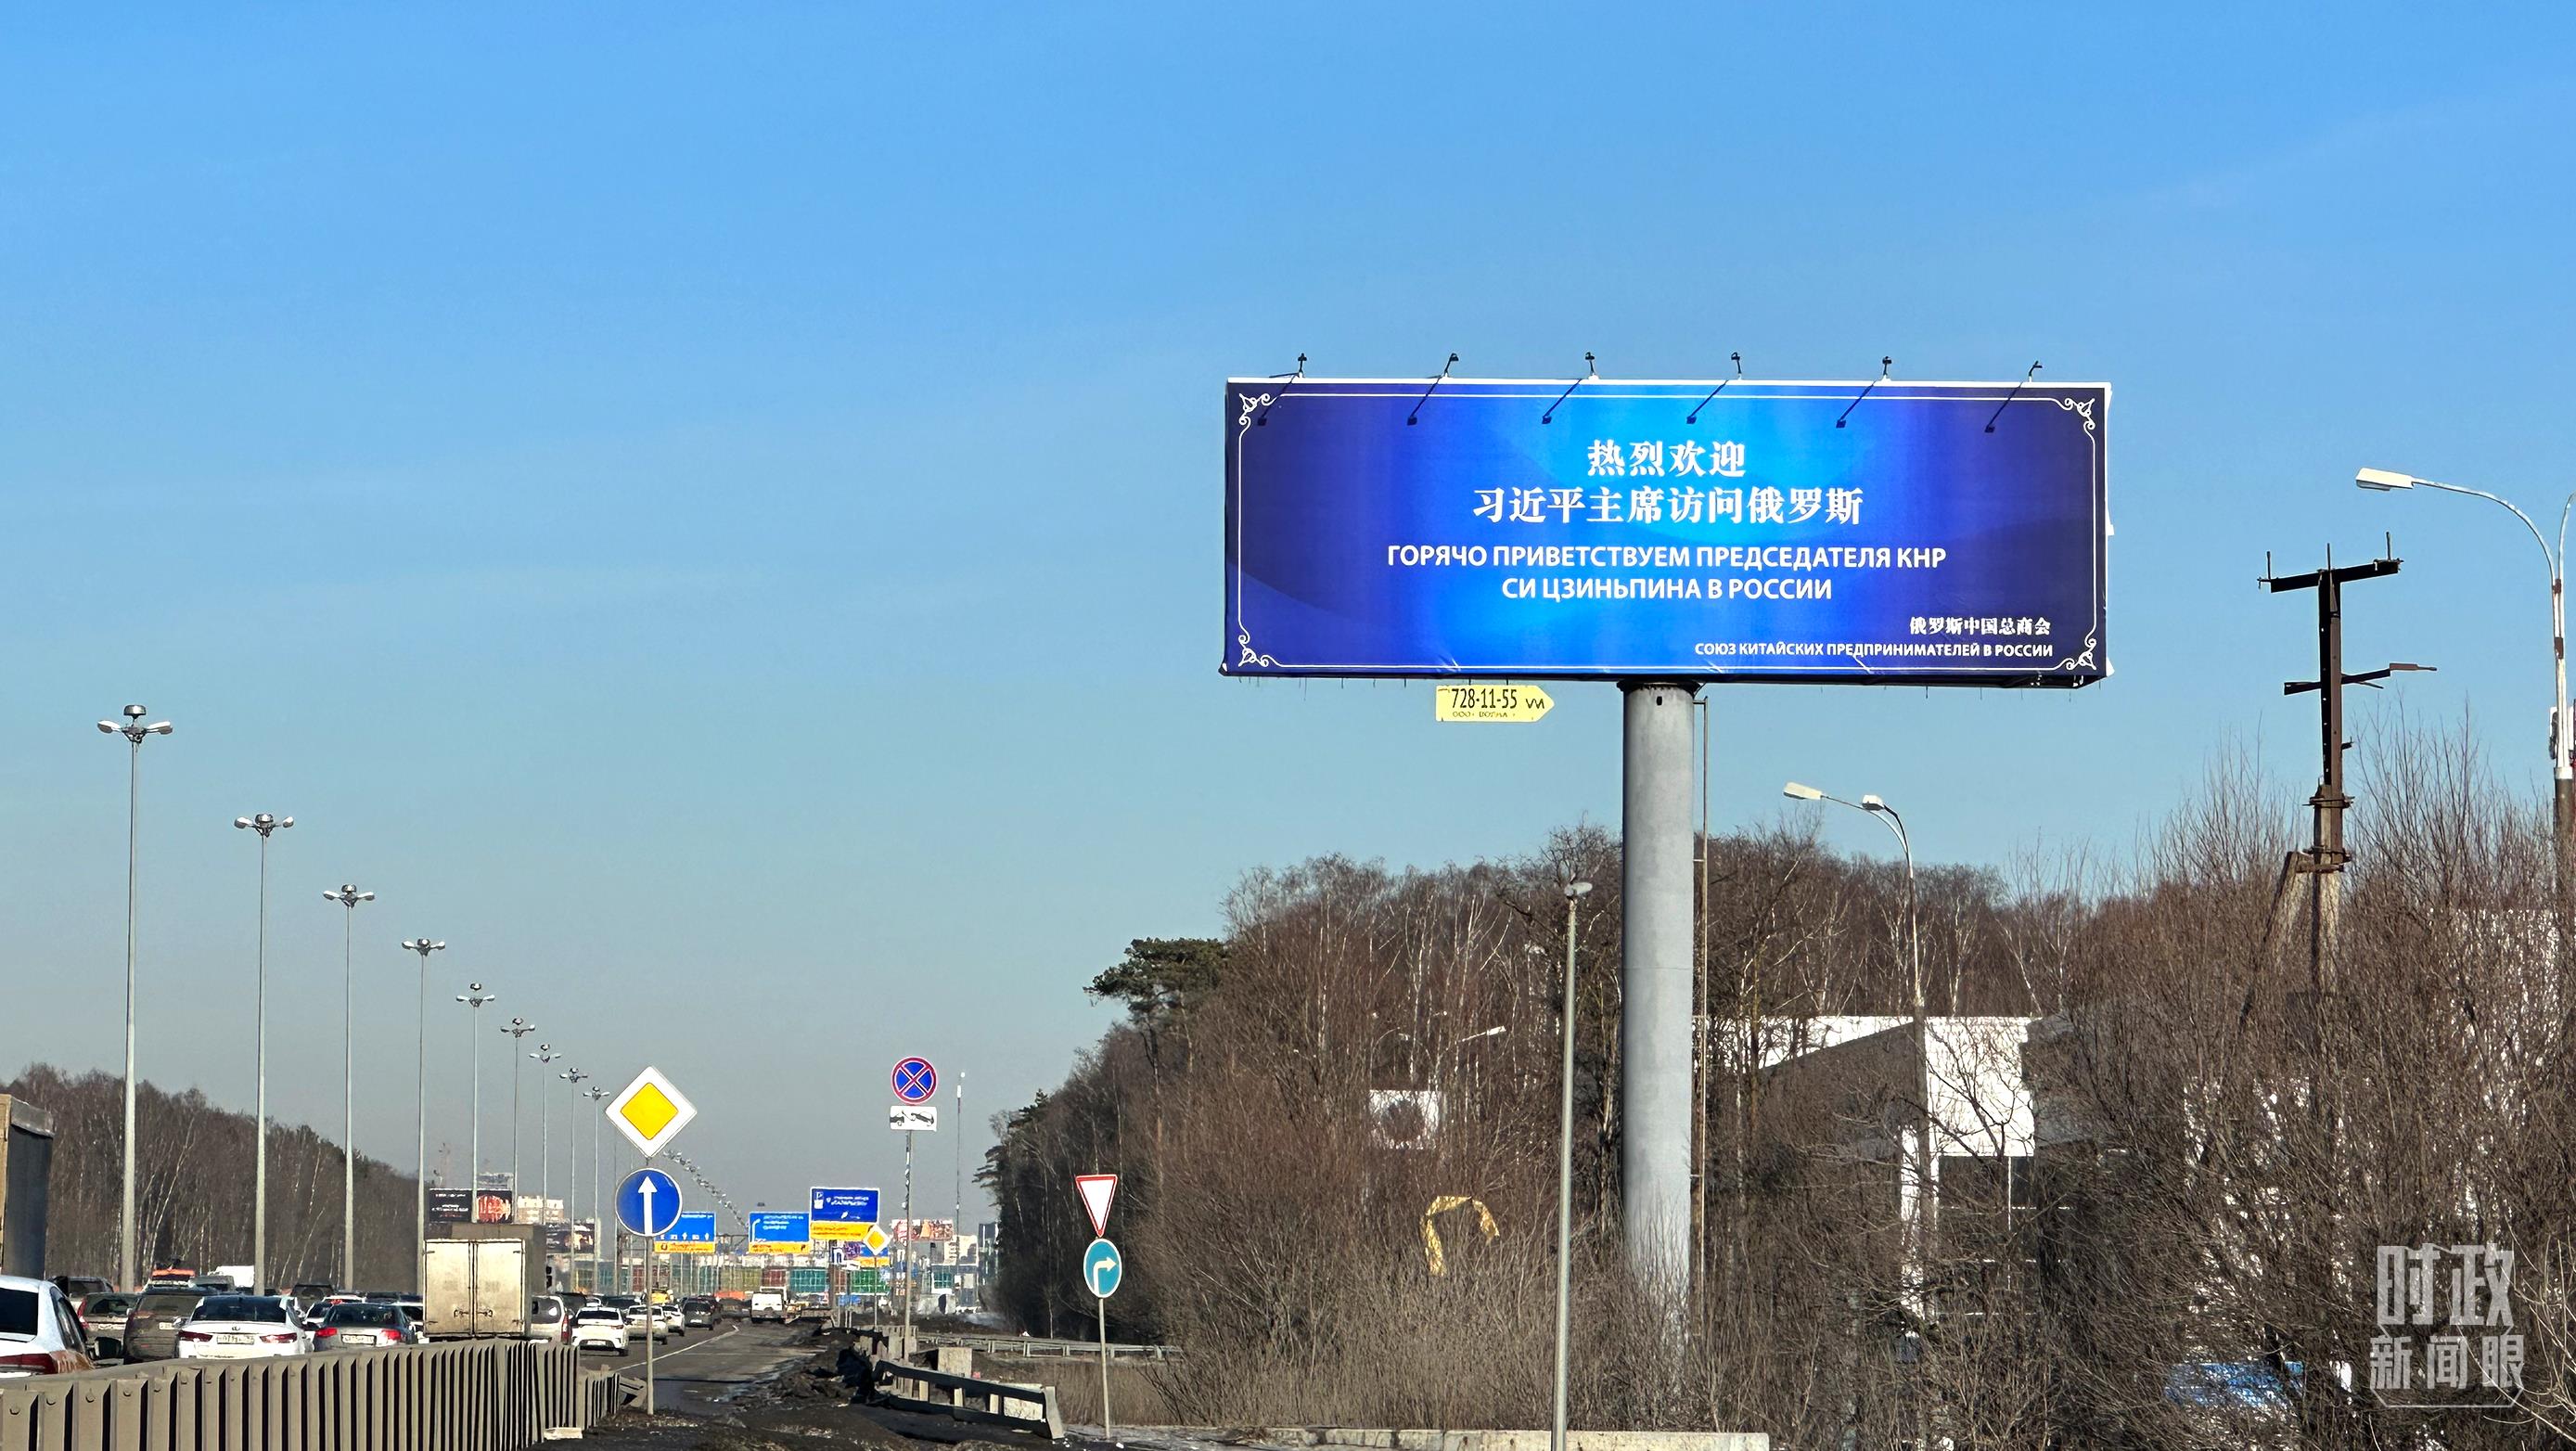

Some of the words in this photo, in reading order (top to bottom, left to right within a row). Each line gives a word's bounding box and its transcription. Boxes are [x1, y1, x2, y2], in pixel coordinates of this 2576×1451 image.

[1587, 440, 1746, 477] 热烈欢迎
[1474, 486, 1864, 525] 习近平主席访问俄罗斯
[1388, 546, 1488, 566] ГОРЯЧО
[1493, 546, 1689, 567] ПРИВЕТСТВУЕМ
[1697, 546, 1890, 571] ПРЕДСЕДАТЕЛЯ
[1897, 547, 1947, 569] КНР
[1502, 578, 1536, 598] СИ
[1543, 578, 1702, 603] ЦЗИНЬПИНА
[1708, 578, 1724, 599] В
[1728, 578, 1832, 599] РОССИИ
[1909, 616, 2052, 636] 俄罗斯中国总商会
[1695, 643, 1737, 655] СОЮЗ
[1739, 641, 1824, 656] КИТАЙСКИХ
[1826, 643, 1980, 659] ПРЕДПРИНИМАТЕЛЕЙ
[1983, 645, 1993, 657] В
[1995, 645, 2053, 657] РОССИИ
[1452, 688, 1518, 709] 728-11-55
